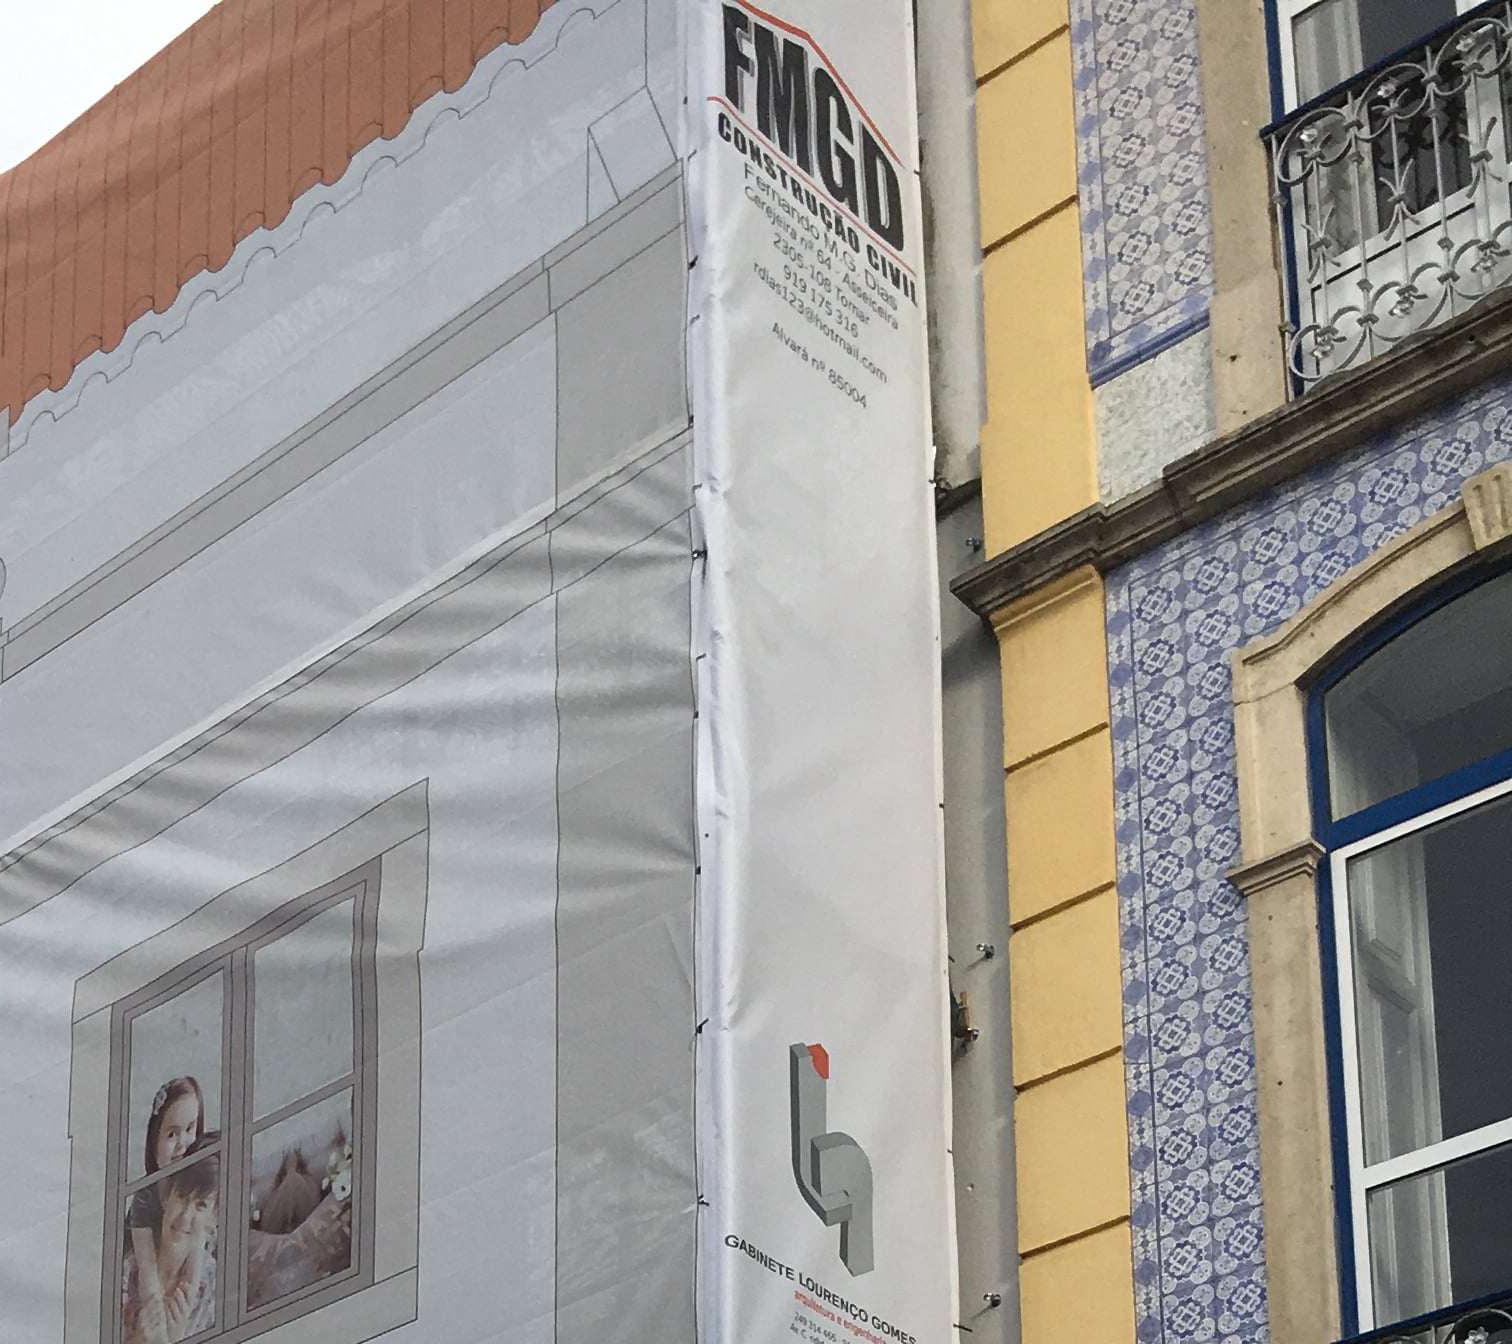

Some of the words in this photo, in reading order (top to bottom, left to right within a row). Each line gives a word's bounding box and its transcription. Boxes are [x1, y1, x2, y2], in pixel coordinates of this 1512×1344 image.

[722, 3, 904, 252] FMGD
[718, 112, 860, 254] CONSTRUÇÃO
[867, 244, 918, 309] CIVIL
[744, 162, 820, 240] Fernando
[865, 268, 898, 311] Dias
[745, 186, 797, 240] Cerejeira
[816, 249, 832, 270] 64
[754, 262, 887, 383] rdias123@hotmail.com
[773, 232, 832, 293] 2305-108
[836, 286, 870, 325] Tomar
[783, 264, 807, 293] 919
[810, 288, 833, 316] 175
[835, 309, 859, 338] 316
[772, 321, 808, 362] Alvará
[828, 368, 867, 408] 85004
[724, 1235, 795, 1281] GABINETE
[799, 1272, 868, 1322] LOURENÇO
